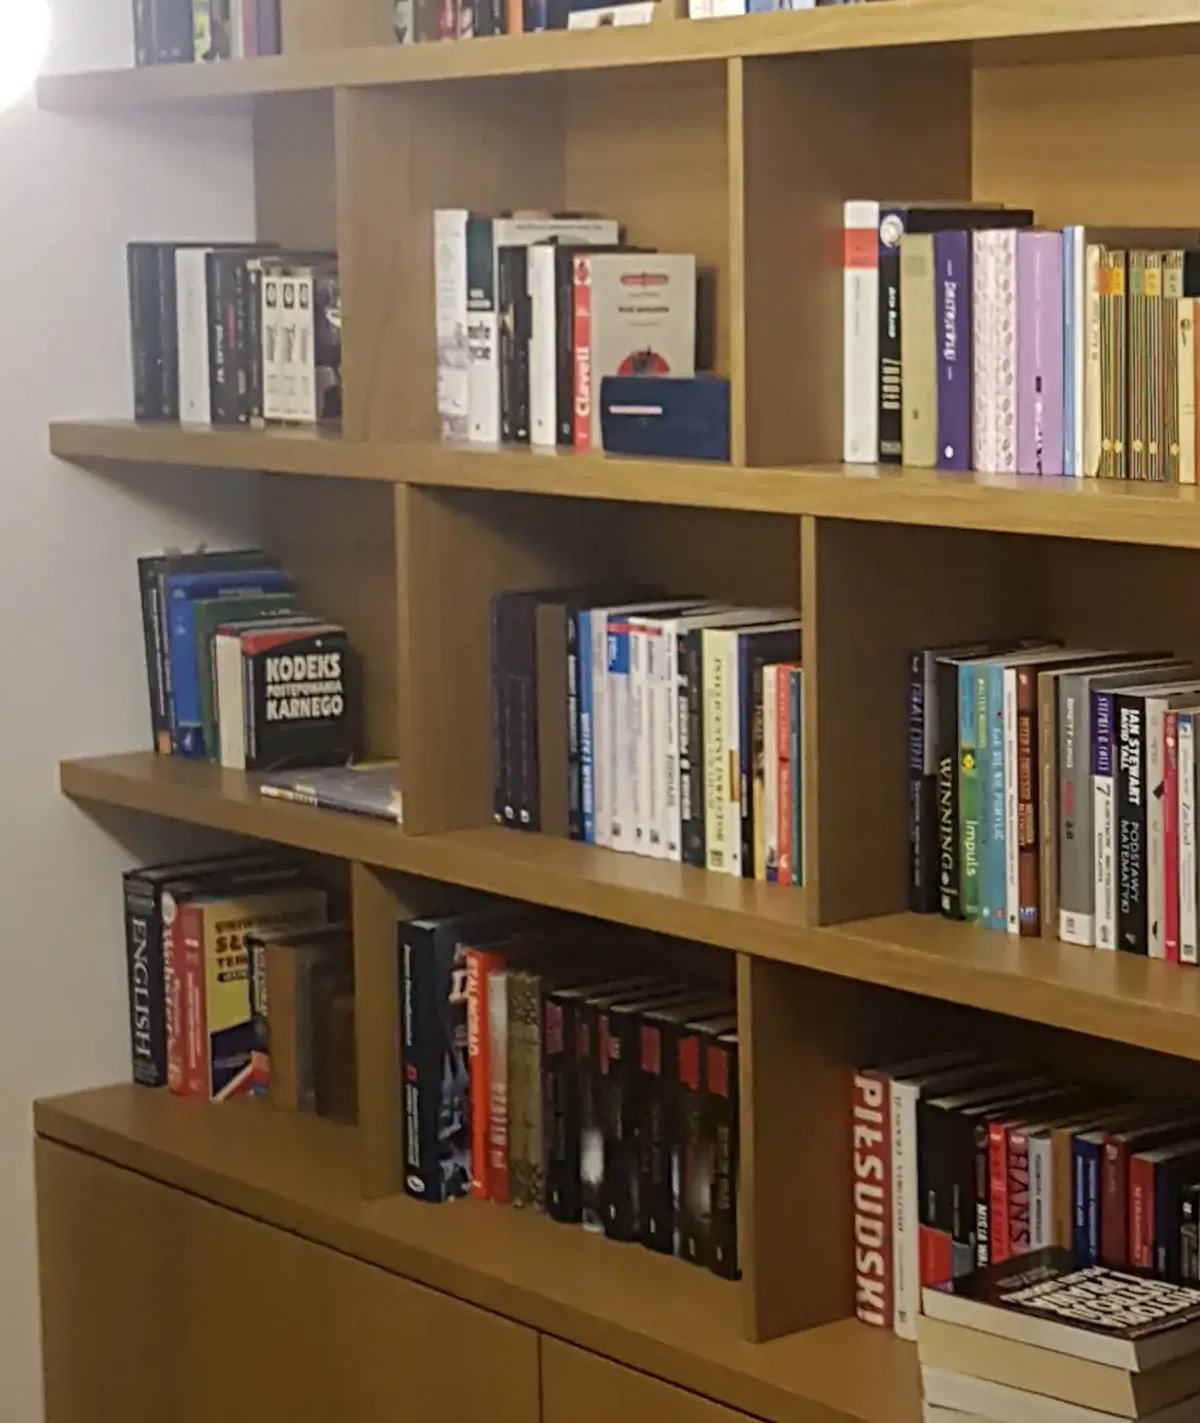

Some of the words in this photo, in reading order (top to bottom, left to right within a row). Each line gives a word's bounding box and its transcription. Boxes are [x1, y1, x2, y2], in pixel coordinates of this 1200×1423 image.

[266, 653, 341, 683] KODEKS
[266, 695, 344, 721] KARNEGO
[1120, 708, 1129, 743] DAVID
[1128, 709, 1140, 736] IAN
[1120, 745, 1129, 770] TALL
[1128, 739, 1140, 806] STEWART
[939, 758, 953, 869] WINNING
[965, 820, 978, 876] Impuls
[1120, 819, 1130, 913] MATEMATYKI
[1129, 821, 1139, 903] PODSTAWY
[132, 918, 151, 1057] ENGLISH
